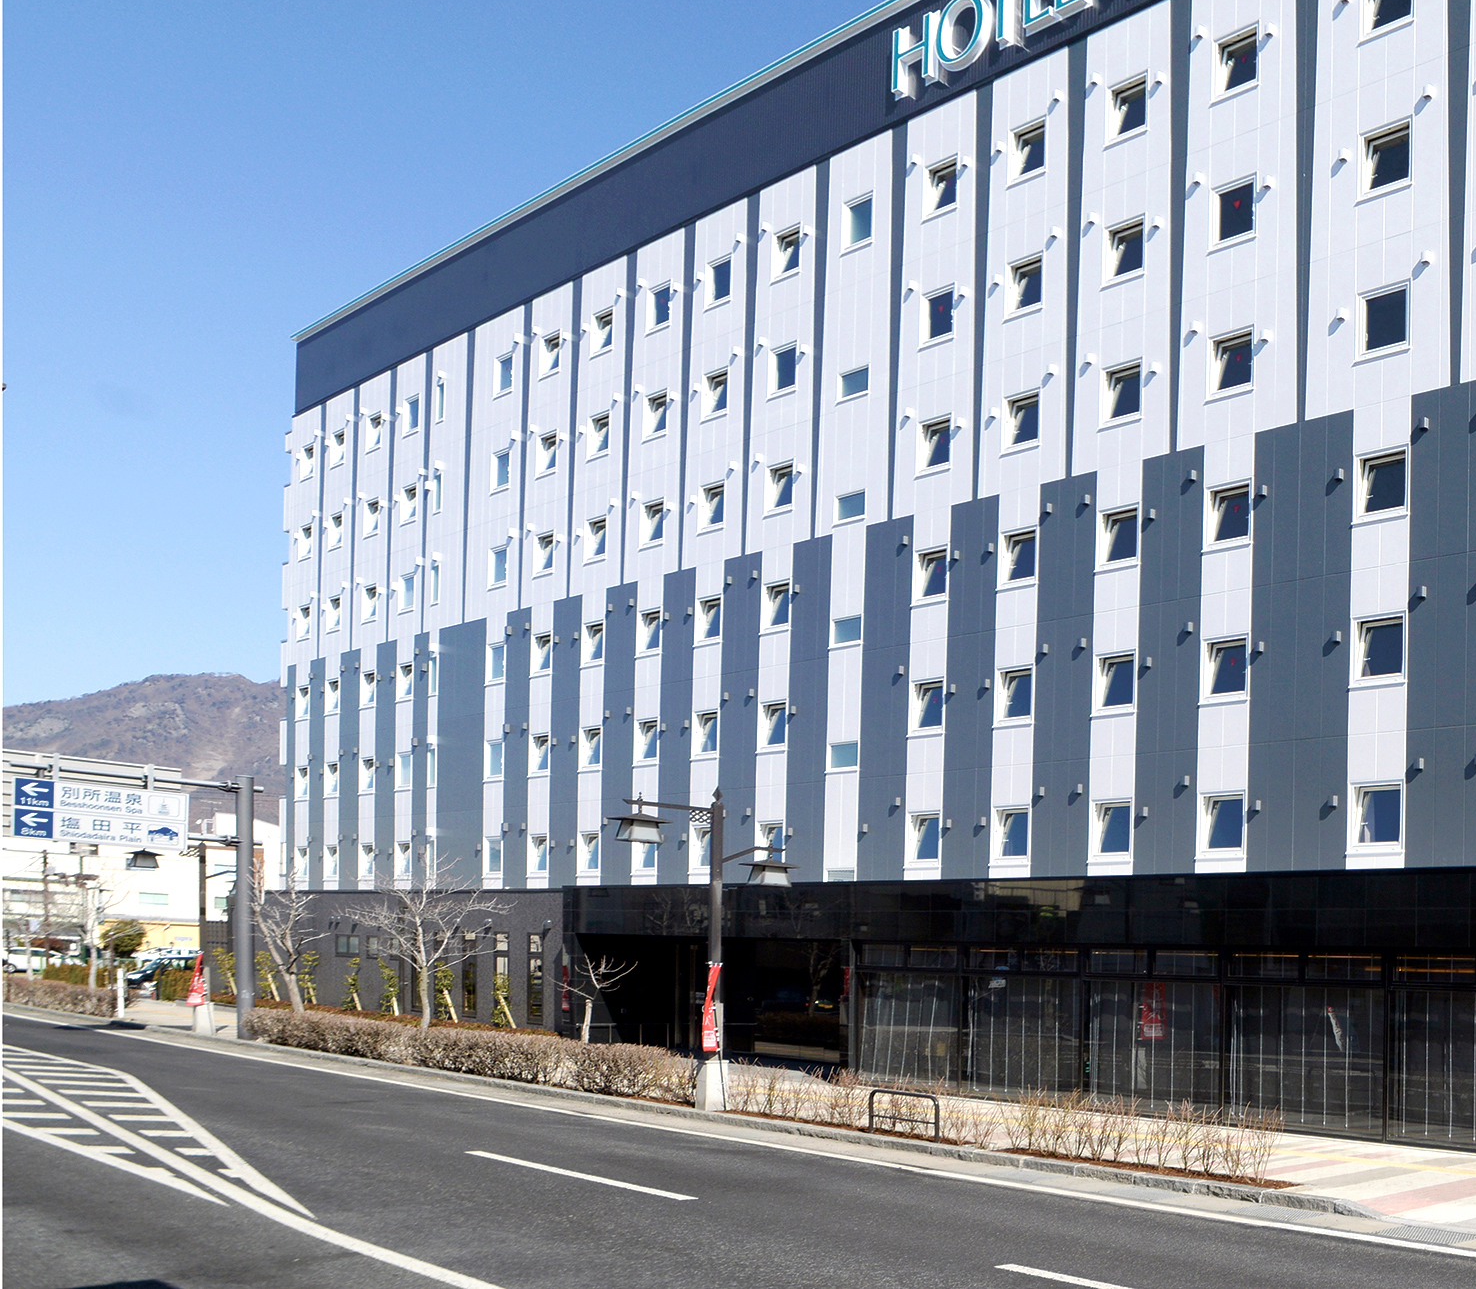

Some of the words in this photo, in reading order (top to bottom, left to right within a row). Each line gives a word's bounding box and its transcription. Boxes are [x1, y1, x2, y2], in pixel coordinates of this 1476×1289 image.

[20, 796, 50, 807] 11km
[61, 786, 142, 806] 別所温泉
[125, 806, 143, 815] Spa
[60, 816, 142, 834] 塩田平
[20, 826, 48, 837] 8km
[119, 834, 142, 844] Plain
